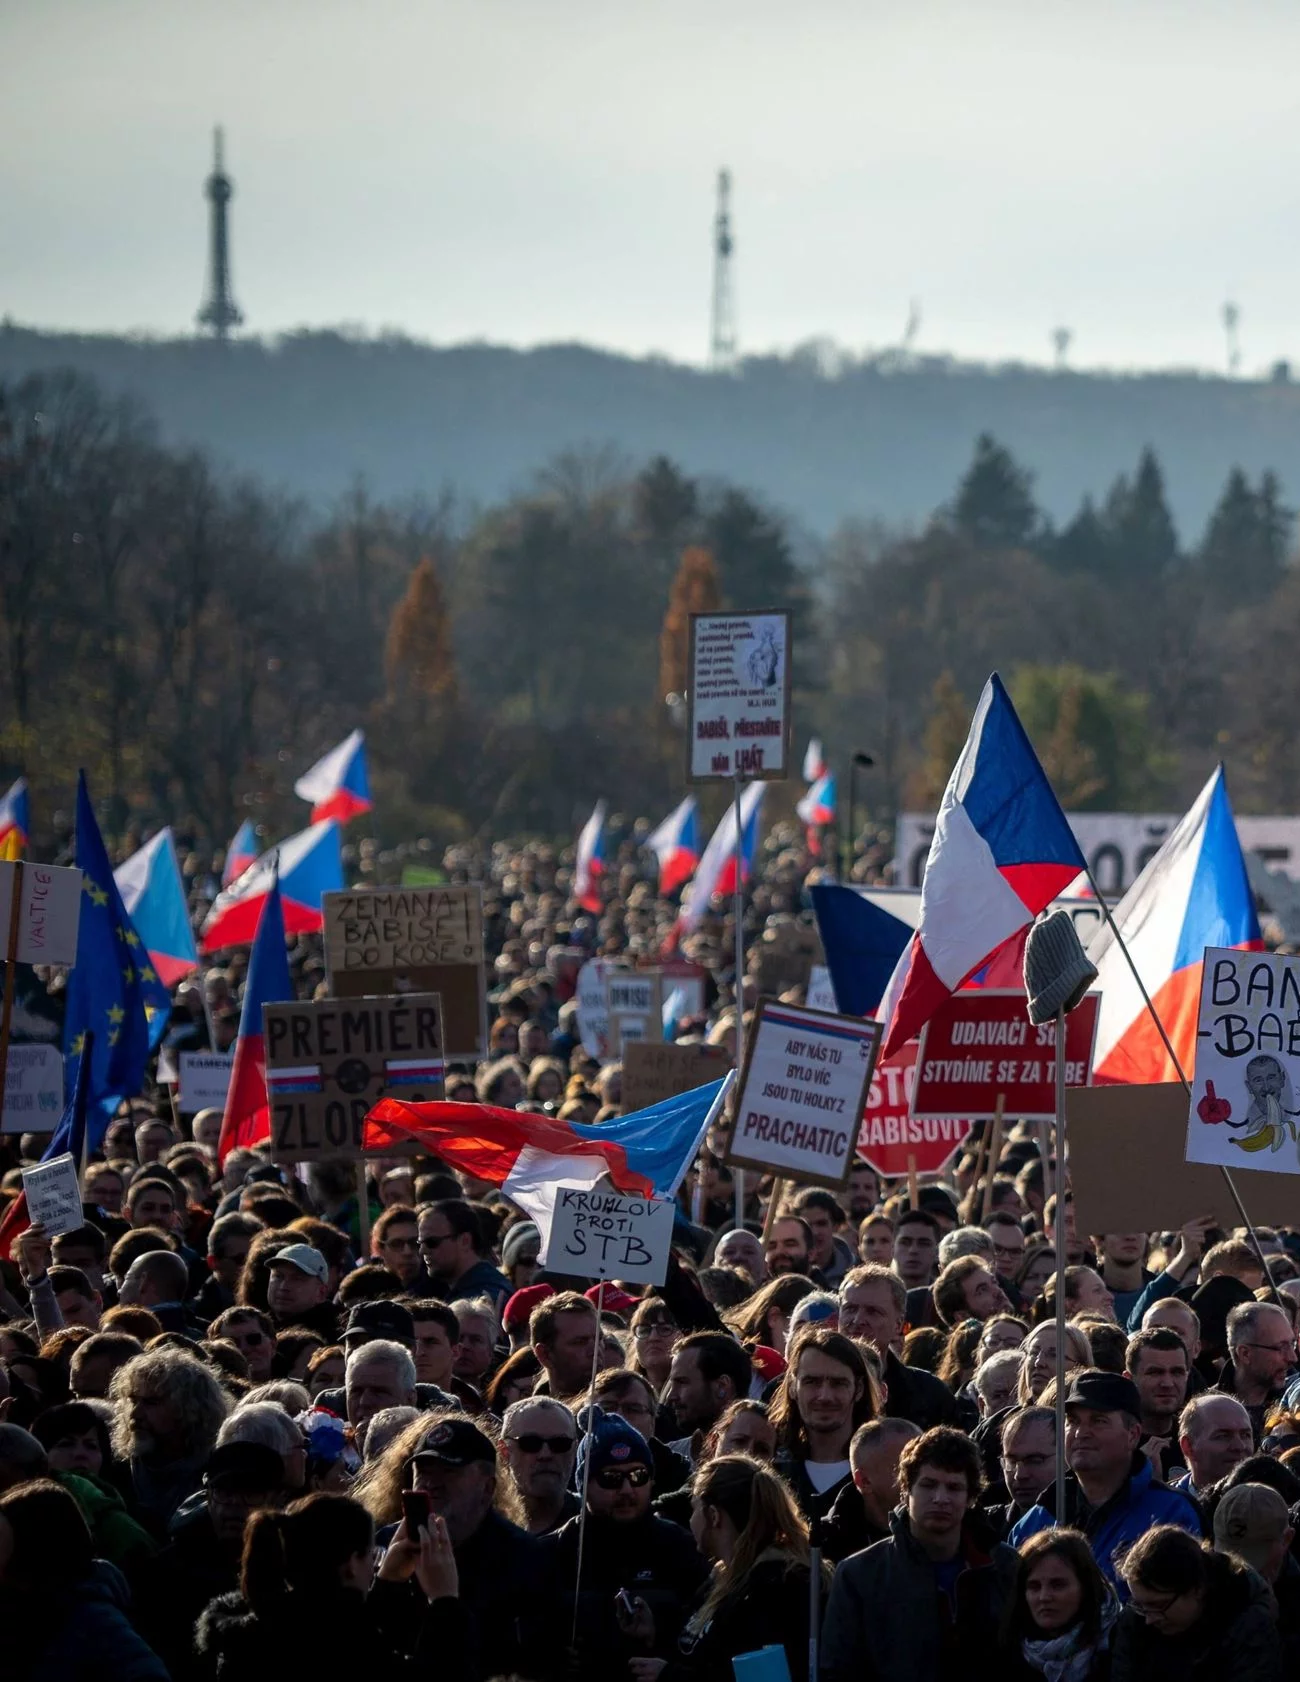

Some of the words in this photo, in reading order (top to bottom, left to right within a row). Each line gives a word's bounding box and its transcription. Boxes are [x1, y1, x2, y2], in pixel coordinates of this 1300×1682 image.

[29, 870, 51, 949] VALTICE
[344, 946, 380, 970] DO
[268, 1000, 440, 1059] PREMIÉR
[951, 1016, 1028, 1046] UDAVAČI
[785, 1039, 807, 1057] ABY
[808, 1042, 828, 1062] NÁS
[828, 1049, 843, 1065] TU
[786, 1063, 813, 1083] BYLO
[814, 1070, 832, 1087] VÍC
[923, 1055, 993, 1084] STYDÍME
[996, 1060, 1015, 1084] SE
[1020, 1060, 1041, 1084] ZA
[1046, 1060, 1087, 1084] TBE
[762, 1081, 788, 1101] JSOU
[790, 1088, 804, 1104] TU
[804, 1091, 837, 1114] HOLKY
[743, 1111, 848, 1158] PRACHATIC
[562, 1191, 661, 1217] KRUMLOV
[573, 1212, 633, 1233] PROTI
[565, 1228, 653, 1266] STB
